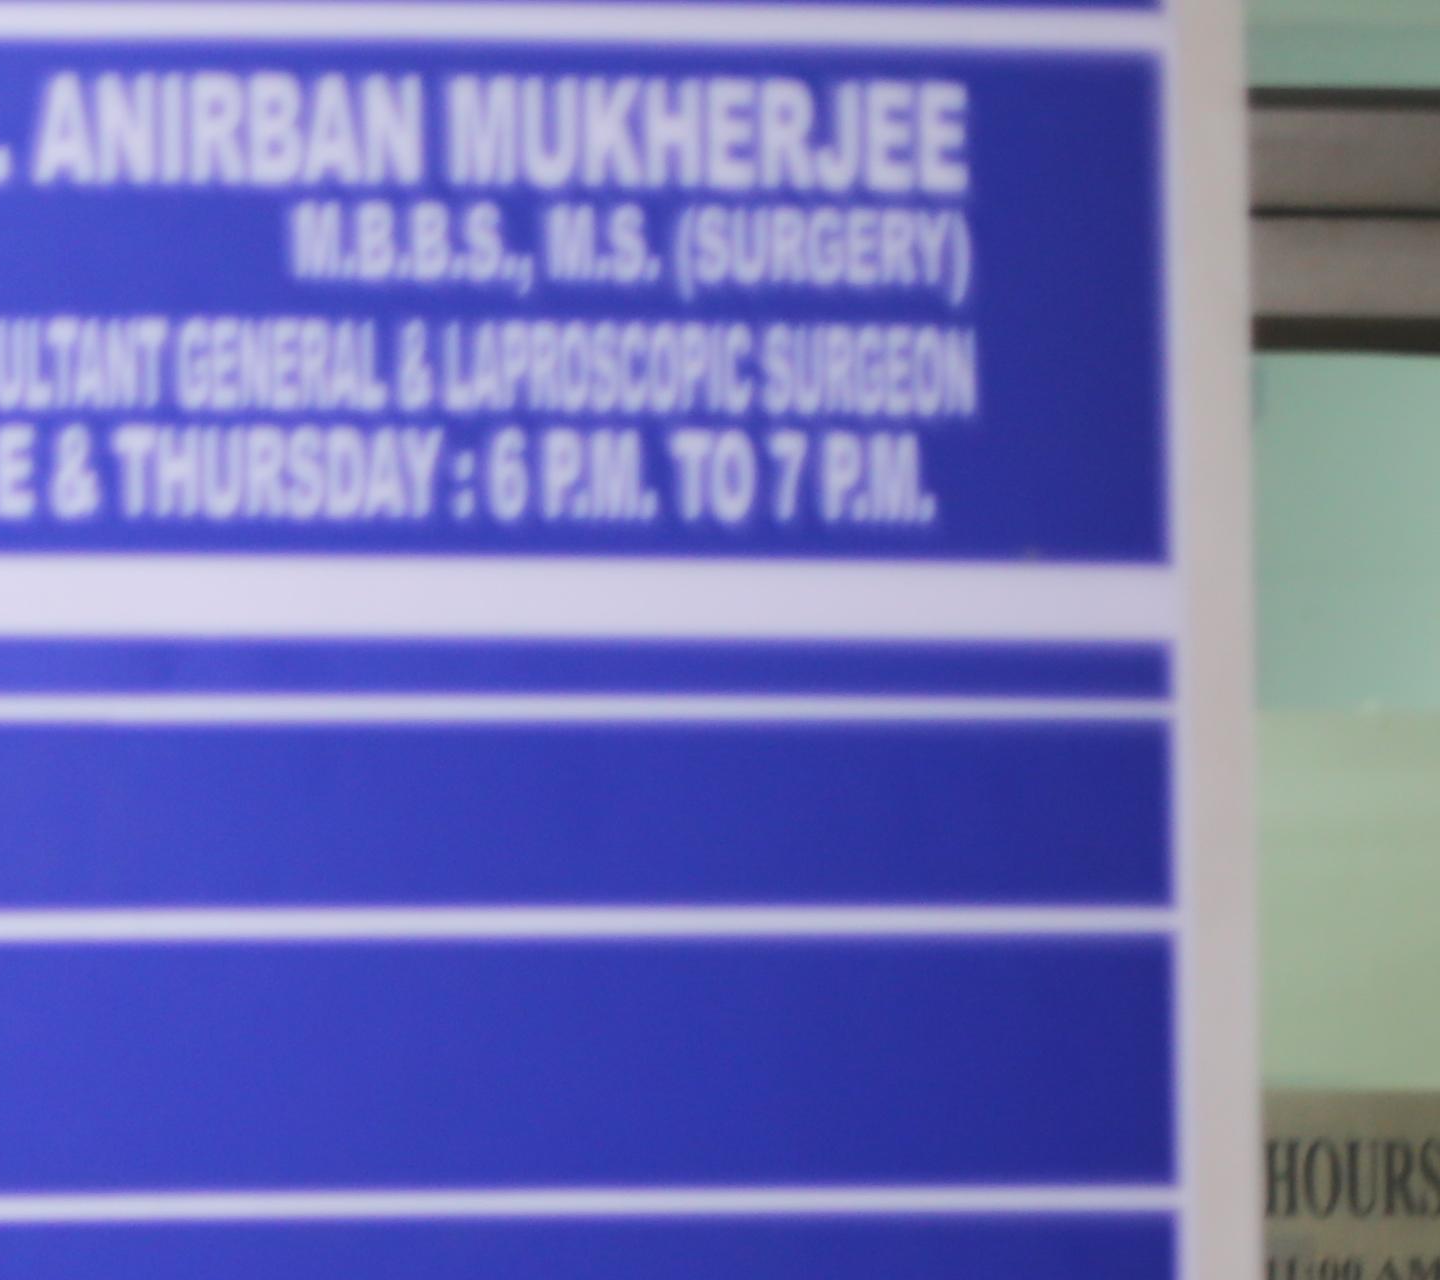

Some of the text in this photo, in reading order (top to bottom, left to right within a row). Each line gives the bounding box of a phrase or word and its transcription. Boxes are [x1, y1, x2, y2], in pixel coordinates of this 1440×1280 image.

[28, 67, 425, 191] ANIRBAN
[442, 70, 969, 196] MUKHERJEE
[288, 198, 971, 305] M.B.B.S., M.S. (SURGERY)
[176, 314, 389, 415] GENERAL
[395, 316, 438, 415] &
[442, 318, 754, 418] LAPROSCOPIC
[761, 320, 977, 420] SURGEON
[46, 420, 102, 523] &
[108, 420, 443, 523] THURSDAY
[452, 448, 476, 520] :
[485, 424, 530, 524] 6
[539, 425, 659, 523] P.M.
[668, 427, 757, 525] TO
[767, 429, 808, 523] 7
[819, 429, 937, 524] P.M.
[1263, 1136, 1440, 1220] HOURS
